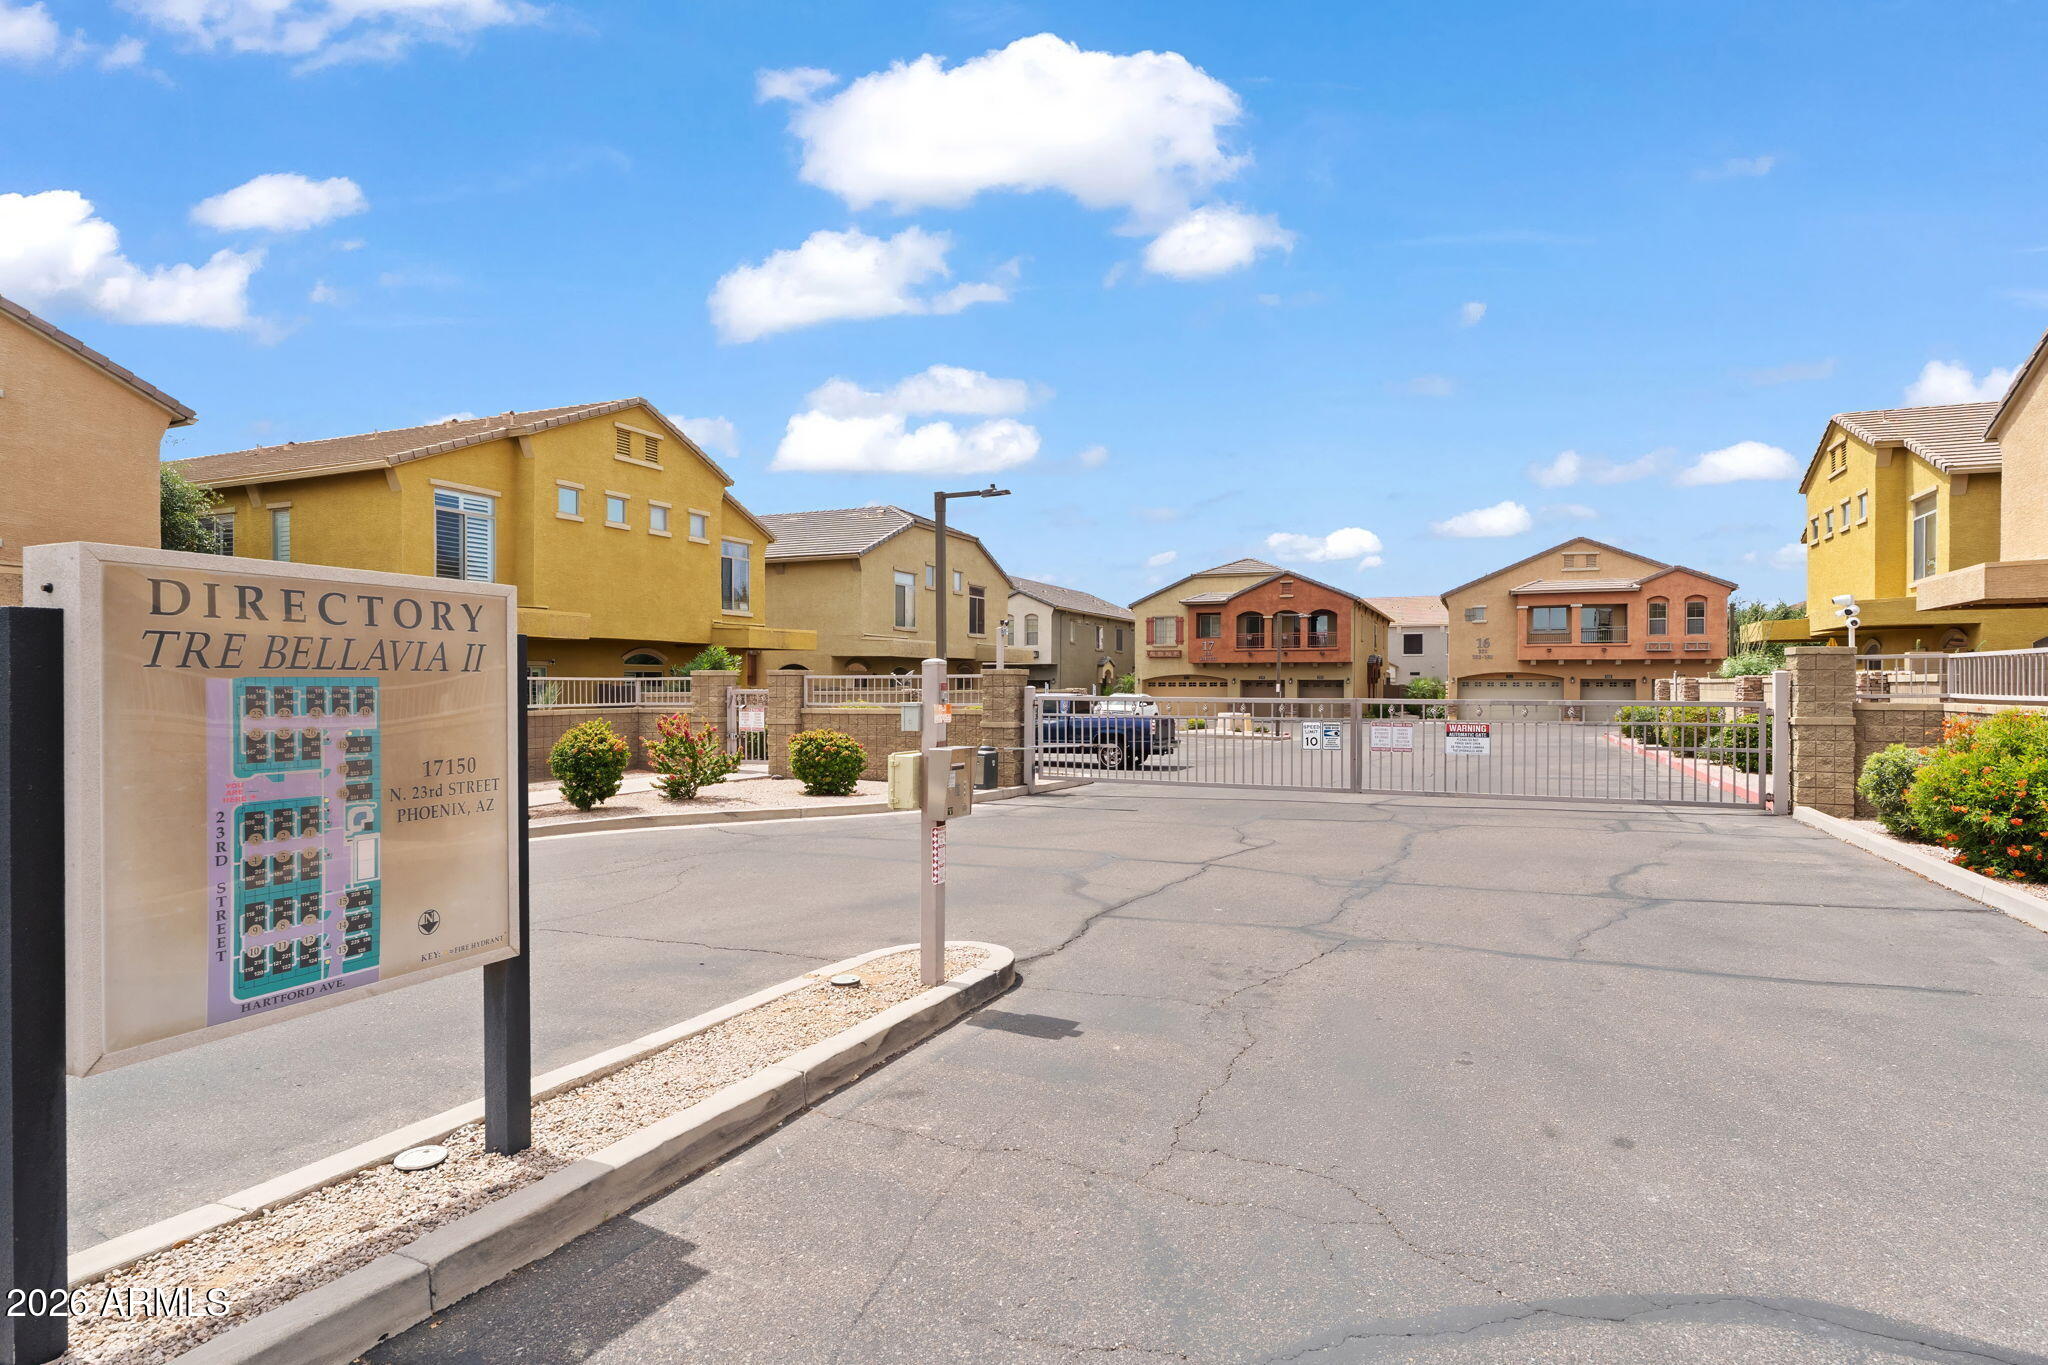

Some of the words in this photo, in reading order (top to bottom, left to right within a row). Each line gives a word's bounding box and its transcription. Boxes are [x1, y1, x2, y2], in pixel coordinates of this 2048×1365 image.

[147, 577, 483, 633] DIRECTORY
[142, 630, 246, 669] TRE
[259, 635, 455, 672] BELLAVIA
[464, 643, 487, 673] II
[1448, 724, 1487, 733] WARNING
[1305, 737, 1318, 748] 10
[422, 756, 476, 778] 17150
[389, 787, 406, 802] N.
[412, 783, 443, 799] 23rd
[448, 778, 500, 796] STREET
[397, 801, 470, 823] PHOENIX,
[475, 798, 495, 813] AZ
[421, 951, 441, 962] KEY:
[471, 935, 504, 949] HYDRANT
[241, 986, 315, 1013] HARTFORD
[320, 979, 345, 993] AVE.
